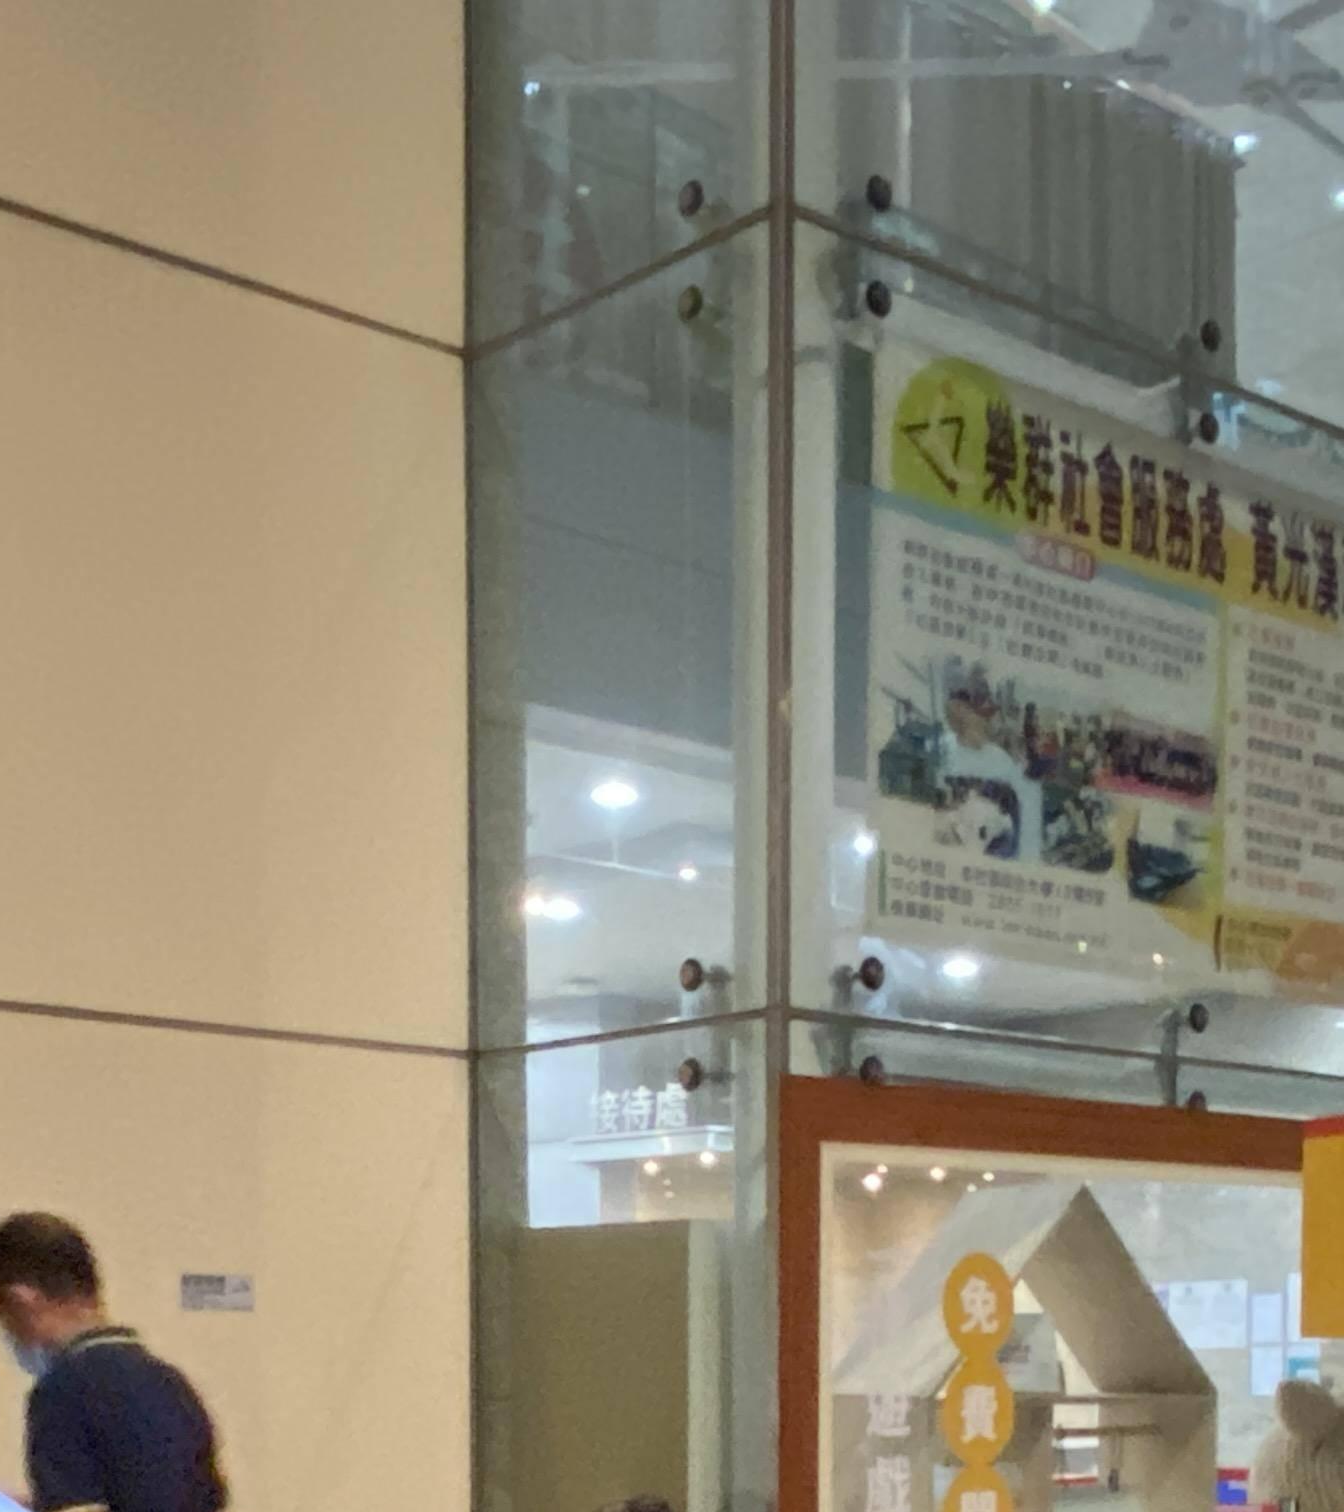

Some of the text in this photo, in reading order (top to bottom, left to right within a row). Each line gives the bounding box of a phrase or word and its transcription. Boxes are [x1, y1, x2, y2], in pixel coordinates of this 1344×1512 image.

[983, 396, 1226, 584] 樂群社會服務處
